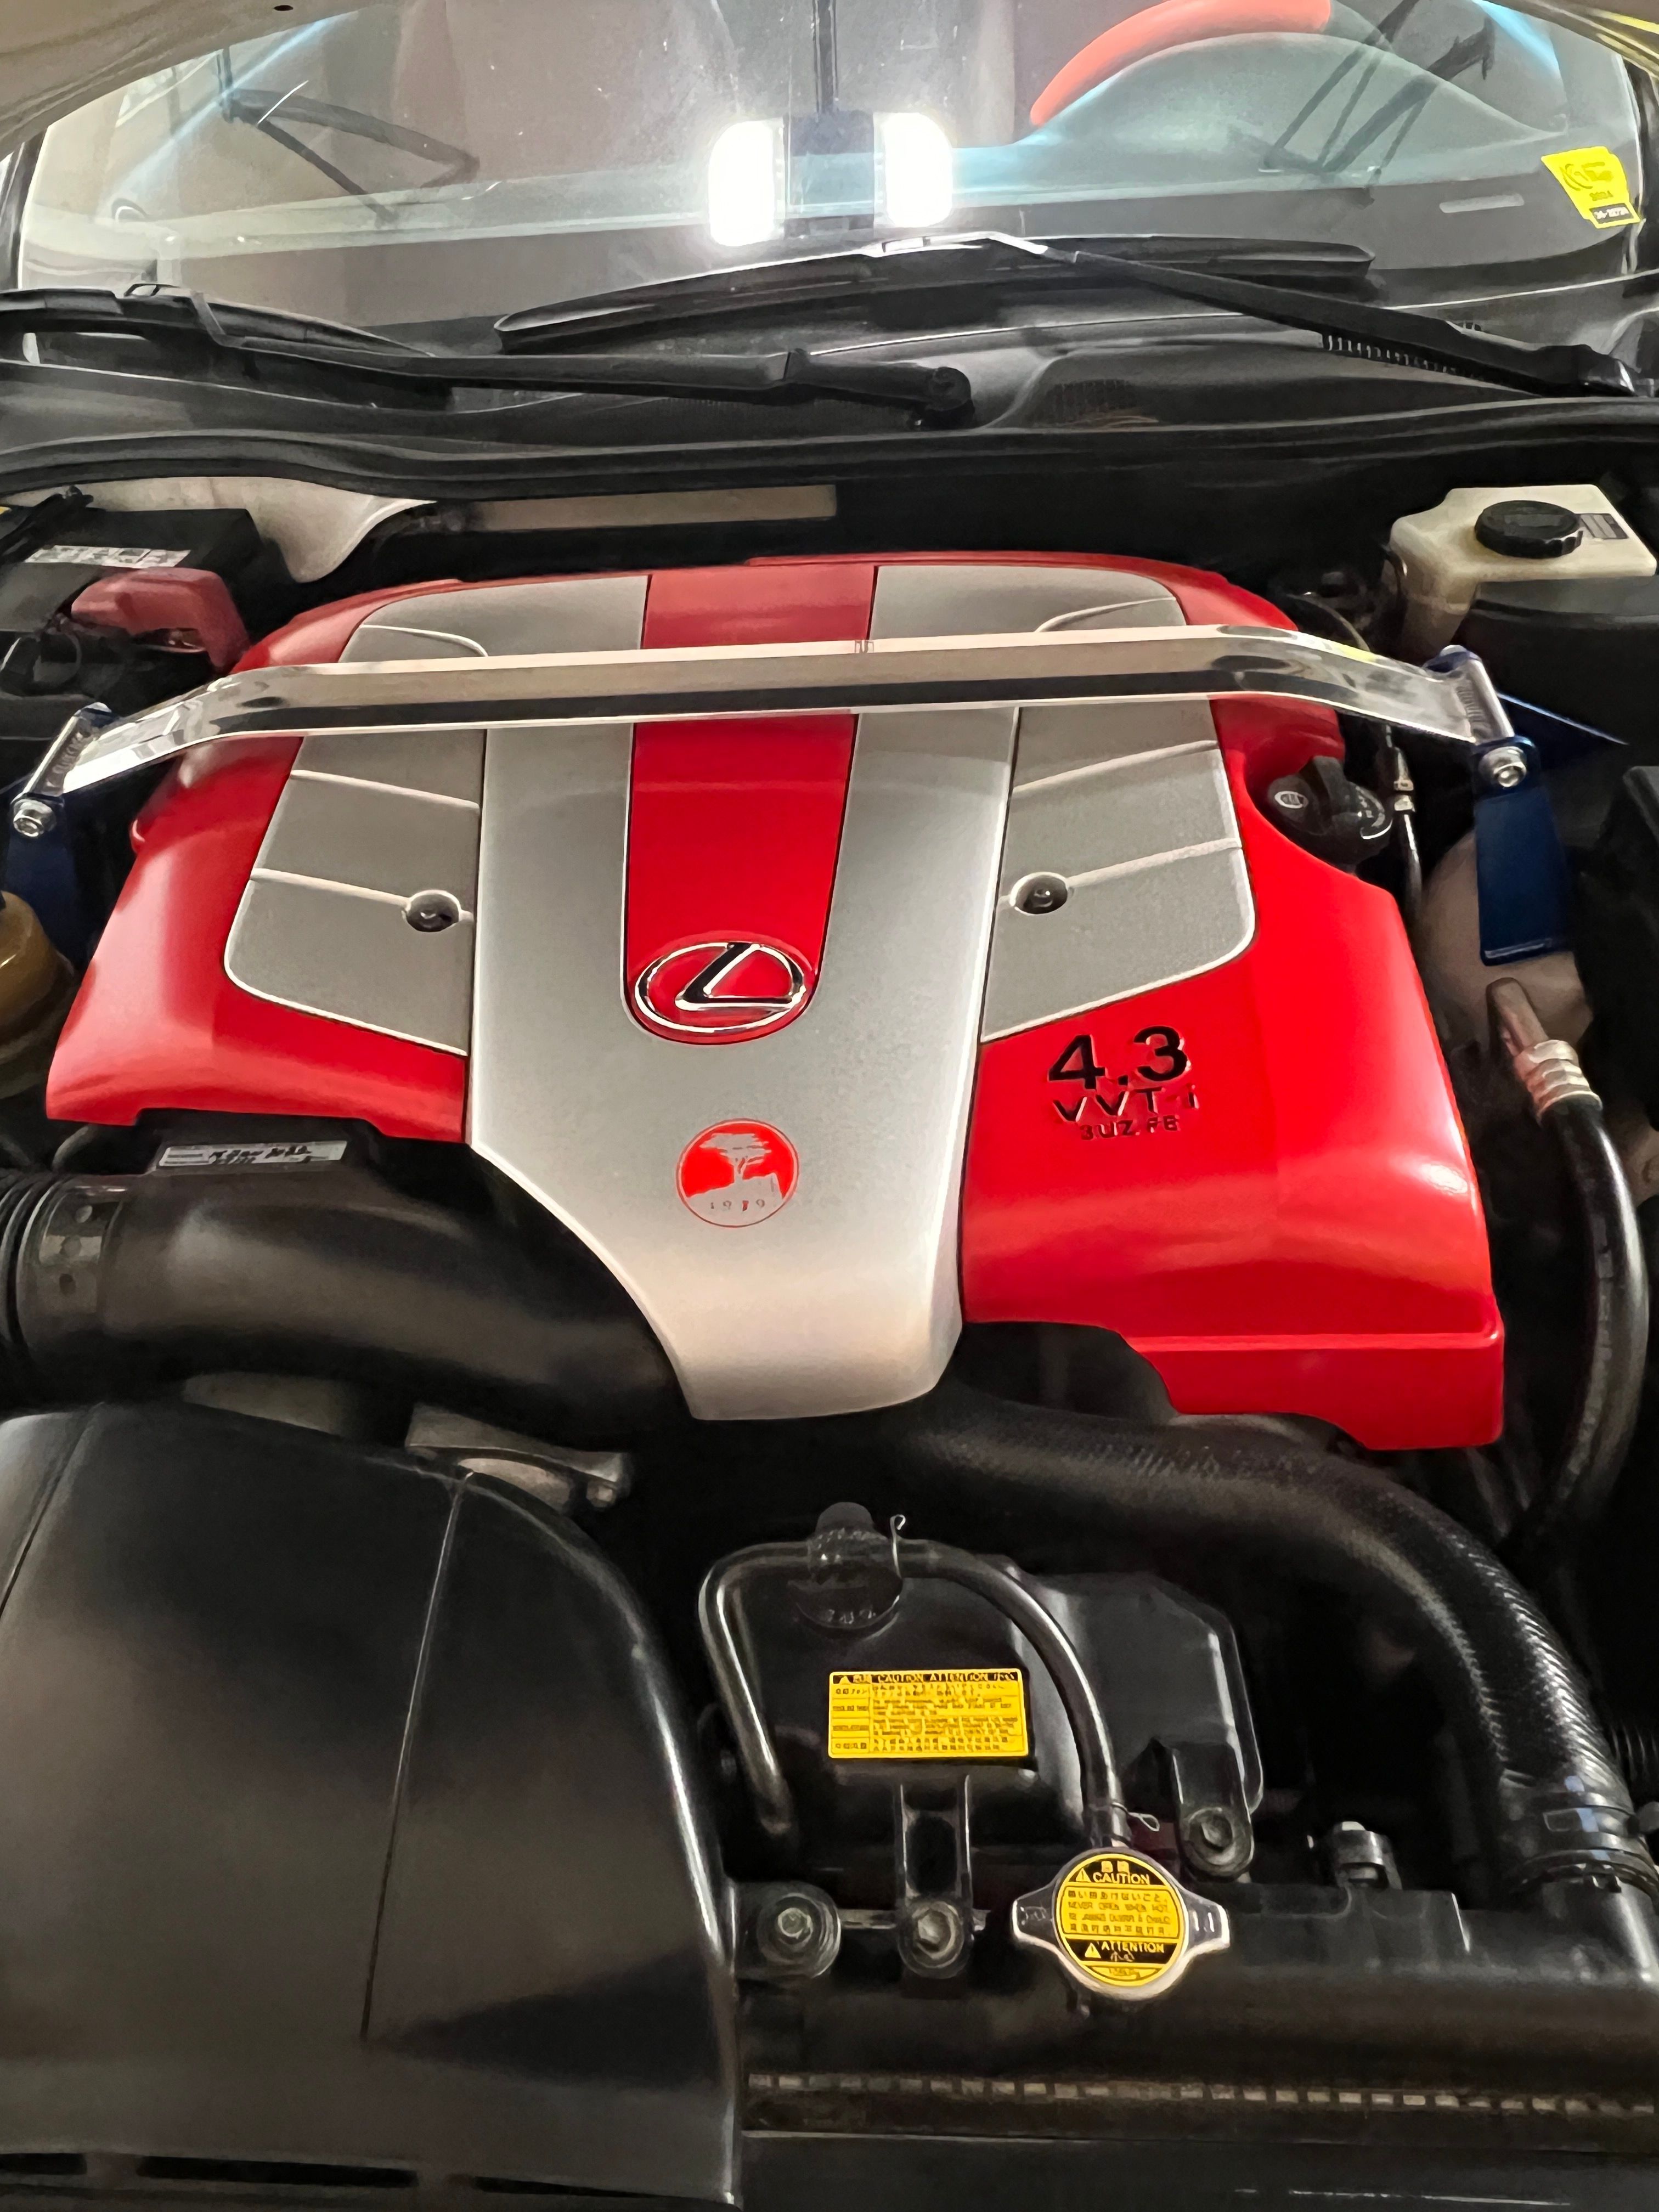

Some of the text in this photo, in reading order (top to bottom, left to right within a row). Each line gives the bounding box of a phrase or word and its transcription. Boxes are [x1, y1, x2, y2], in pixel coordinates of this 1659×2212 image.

[1048, 1025, 1192, 1090] 4.3
[1092, 1871, 1150, 1885] CAUTION
[1101, 1940, 1165, 1954] ATTENTION
